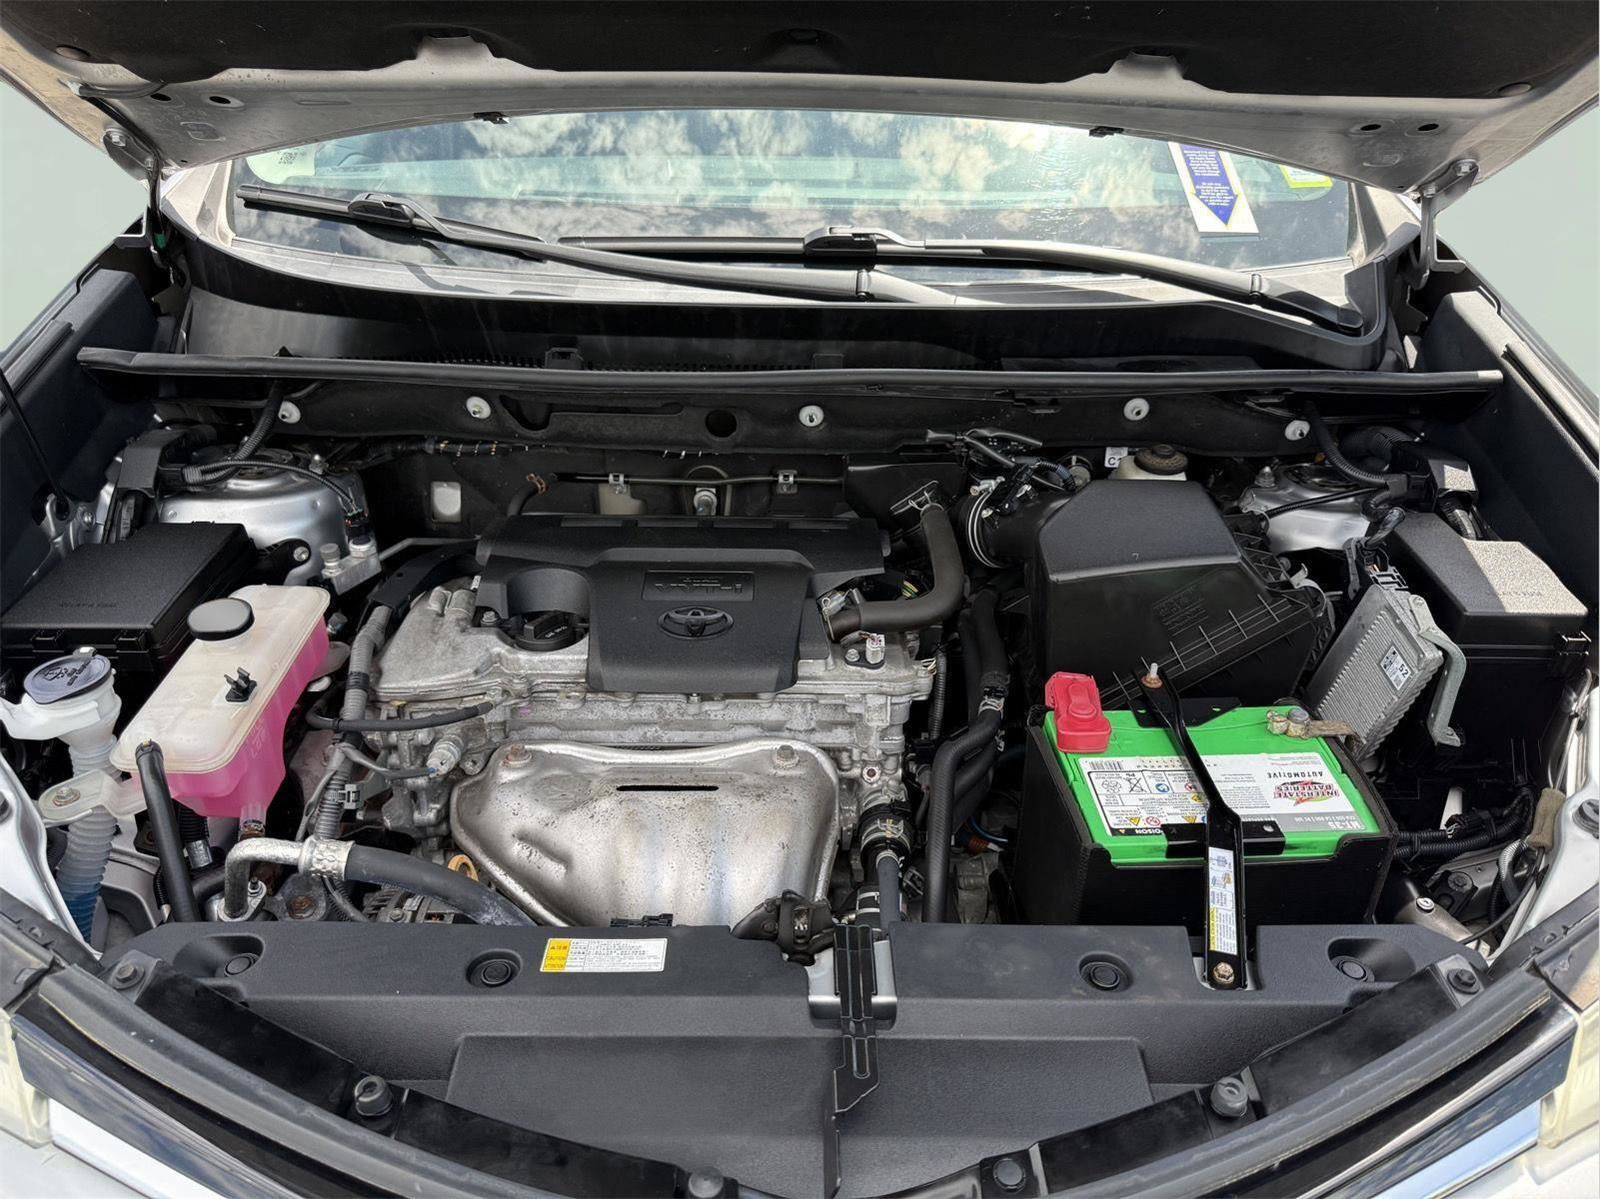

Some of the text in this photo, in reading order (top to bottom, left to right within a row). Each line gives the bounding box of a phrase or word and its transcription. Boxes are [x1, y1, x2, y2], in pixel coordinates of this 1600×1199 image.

[1266, 771, 1323, 779] AUTOMOTIVE
[1275, 784, 1333, 792] BATTERIES
[1274, 790, 1339, 799] INTERSTATE
